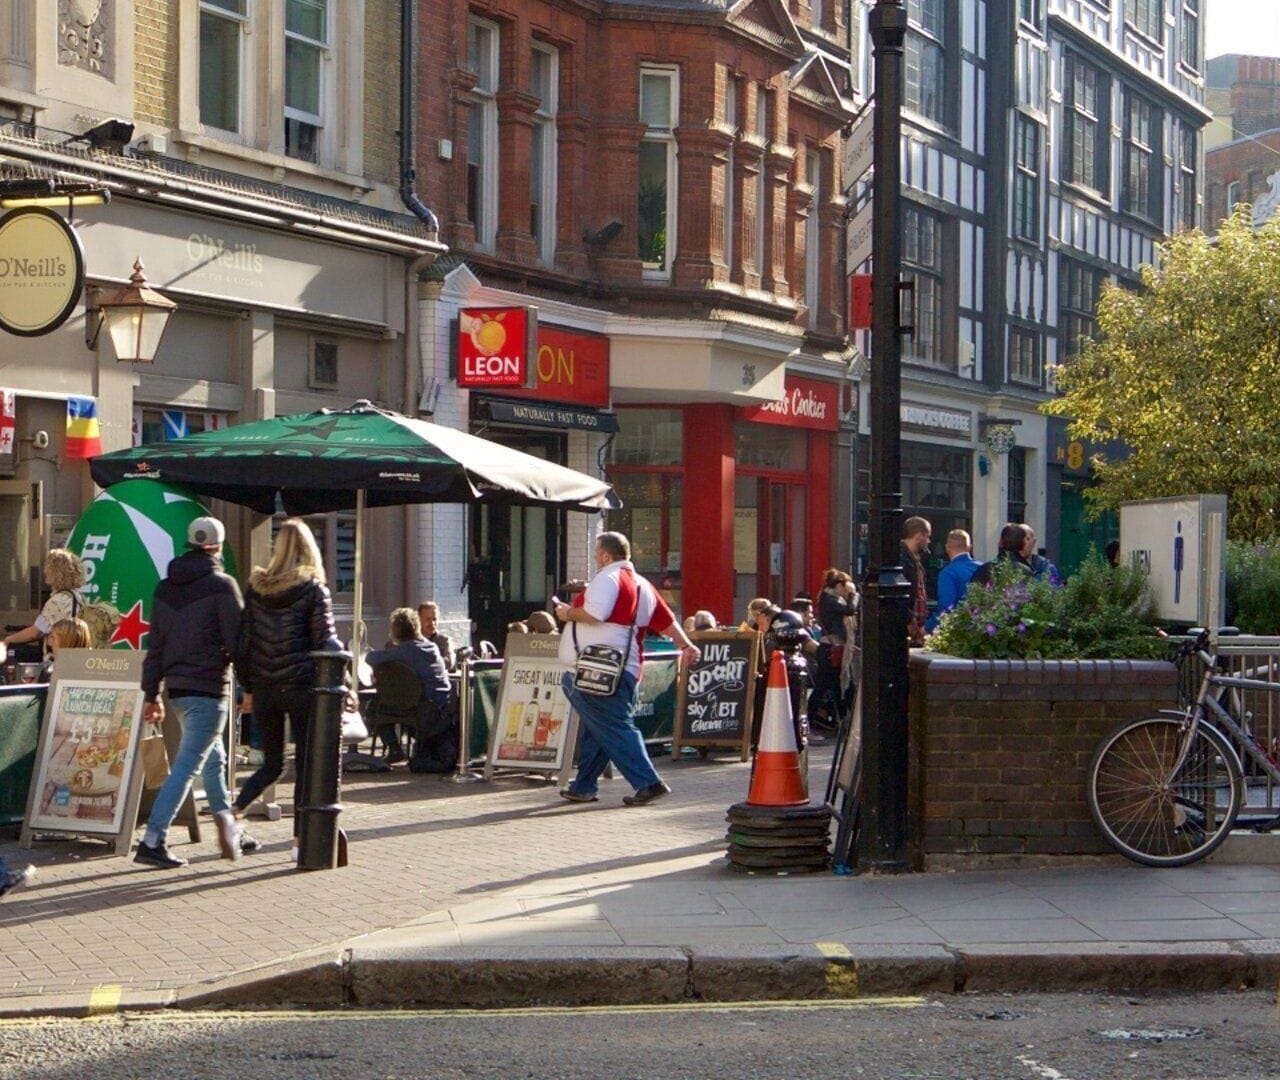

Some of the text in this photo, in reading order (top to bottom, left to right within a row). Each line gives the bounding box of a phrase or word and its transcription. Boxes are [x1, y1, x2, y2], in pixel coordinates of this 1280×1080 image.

[187, 233, 263, 273] O'Neill's
[465, 357, 520, 375] LEON
[537, 344, 574, 385] ON
[792, 388, 826, 419] Cookies
[512, 407, 598, 426] NATURALLY FAST FOOD
[703, 644, 730, 662] LIVE
[85, 657, 130, 671] O'Neill's
[513, 670, 541, 686] GREAT
[65, 700, 113, 714] LUNCH DEAL
[688, 701, 708, 718] sky
[720, 702, 738, 717] BT
